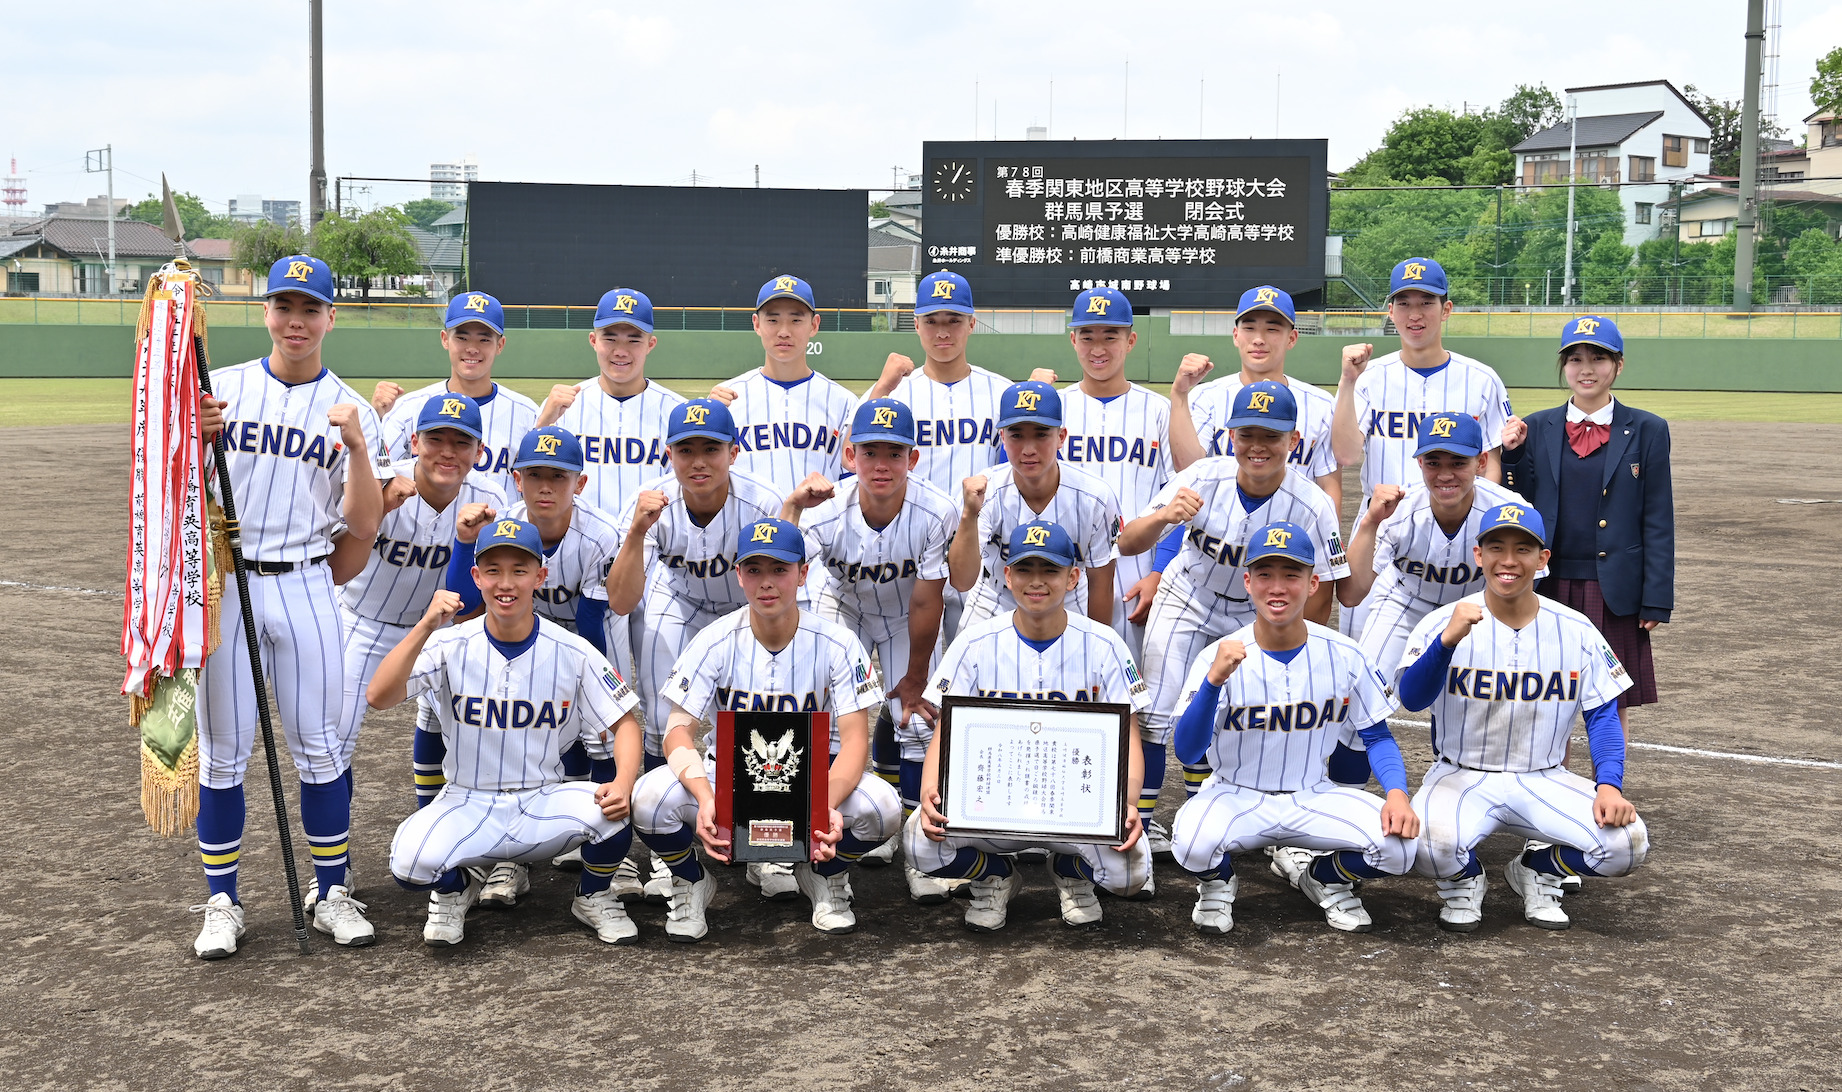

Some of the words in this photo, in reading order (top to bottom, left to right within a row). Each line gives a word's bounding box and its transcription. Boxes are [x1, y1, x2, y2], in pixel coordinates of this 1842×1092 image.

[1006, 178, 1286, 198] 春季関東地区高等学校野球大会
[1045, 202, 1143, 221] 群馬県予選
[1185, 201, 1244, 221] 閉会式
[940, 246, 976, 256] 糸井商事
[284, 261, 313, 282] KT
[1402, 262, 1426, 280] KT
[773, 276, 797, 293] KT
[931, 280, 955, 299] KT
[464, 294, 489, 313] KT
[613, 294, 638, 315] KT
[1086, 296, 1110, 315] KT
[1253, 288, 1278, 305] KT
[1573, 318, 1600, 336] KT
[439, 398, 466, 419] KT
[1014, 390, 1041, 411] KT
[1247, 391, 1274, 413] KT
[683, 404, 710, 425] KT
[871, 407, 897, 429] KT
[1429, 417, 1457, 438] KT
[534, 434, 562, 456] KT
[1496, 505, 1524, 523] KT
[493, 520, 521, 539] KT
[750, 523, 777, 543] KT
[1022, 526, 1050, 546] KT
[1264, 528, 1291, 549] KT
[1448, 666, 1580, 702] KENDAi
[1223, 696, 1351, 733] KENDAi
[1072, 748, 1080, 765] 優勝
[1080, 755, 1092, 794] 表彰状
